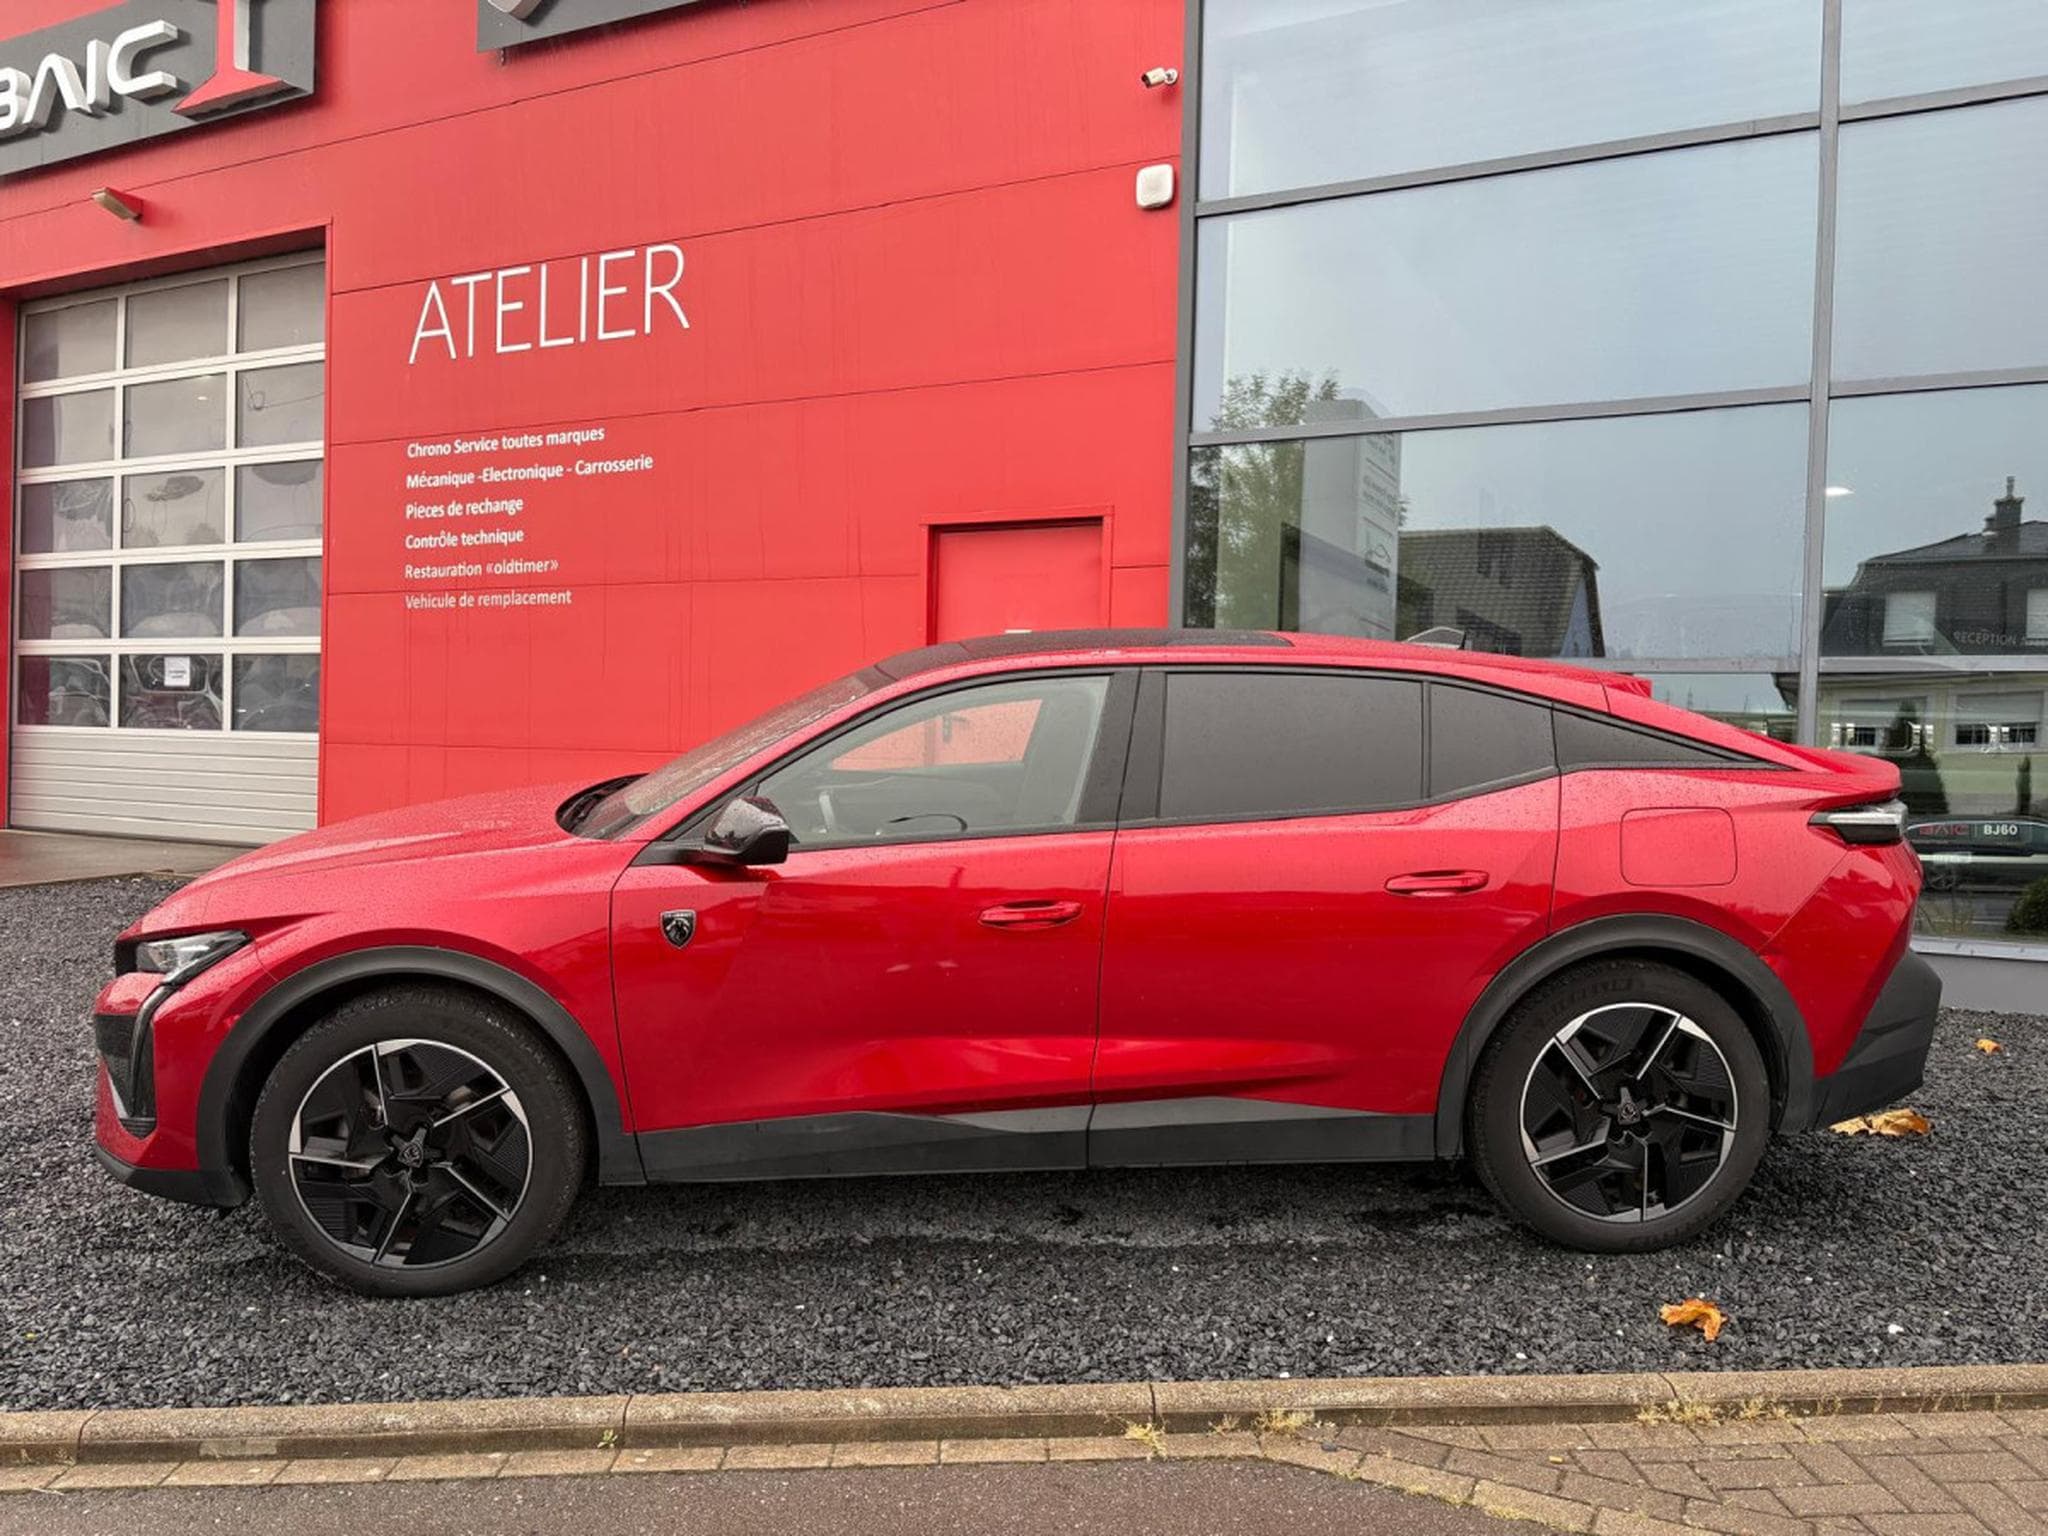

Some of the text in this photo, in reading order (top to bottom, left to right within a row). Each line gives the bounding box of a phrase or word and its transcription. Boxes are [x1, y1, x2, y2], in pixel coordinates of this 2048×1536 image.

[408, 243, 690, 364] ATELIER
[407, 428, 605, 458] Chrono Service toutes marques
[406, 471, 475, 488] Mécanique
[575, 454, 654, 475] Carrosserie
[447, 500, 463, 516] de
[466, 497, 524, 516] rechange
[461, 529, 524, 547] technique
[405, 561, 482, 579] Restauration
[405, 590, 573, 609] Vehicule de remplacement
[1953, 630, 2018, 646] RECEPTION
[1983, 824, 2018, 836] BJ60
